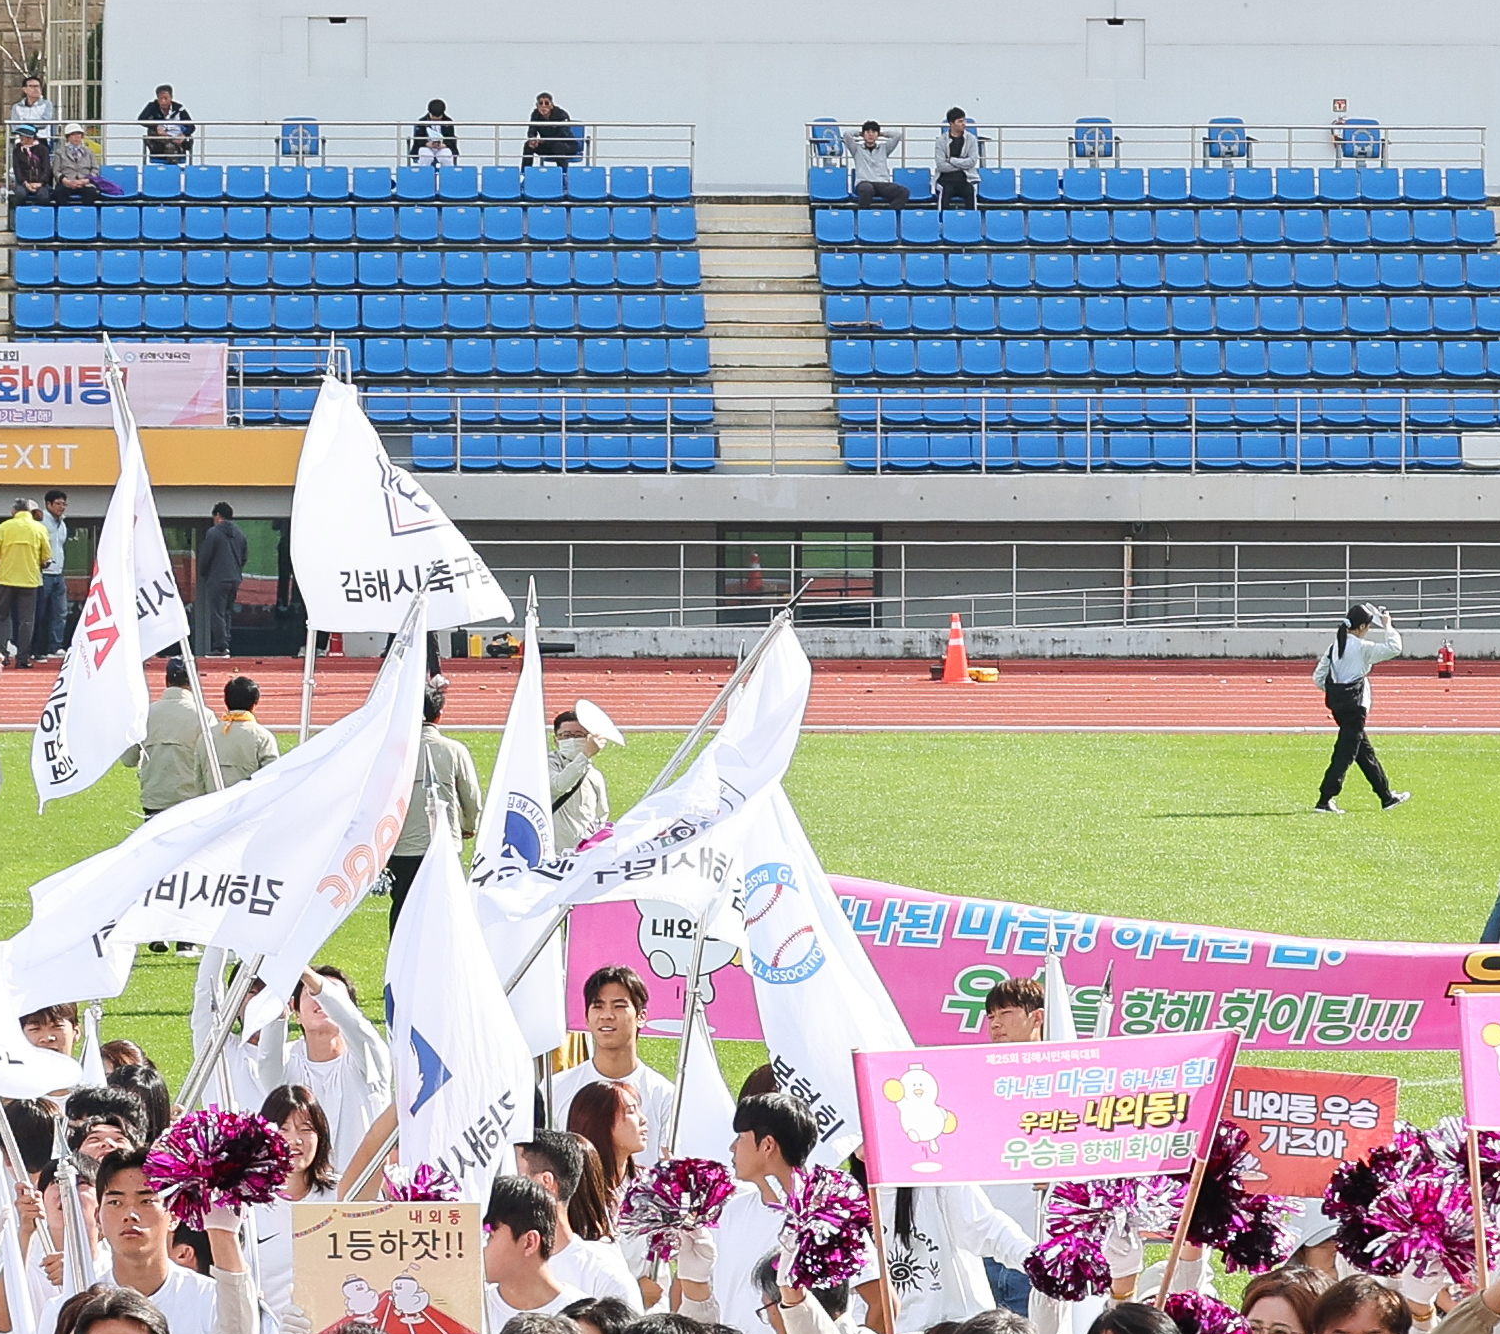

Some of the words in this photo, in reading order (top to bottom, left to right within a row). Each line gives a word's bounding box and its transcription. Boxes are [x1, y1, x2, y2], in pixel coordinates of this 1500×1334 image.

[956, 897, 1098, 957] 마음!
[1121, 991, 1204, 1035] 향해
[1216, 987, 1425, 1043] 화이팅!!!
[994, 1076, 1051, 1098] 하나된
[1057, 1068, 1115, 1095] 마음!
[1122, 1068, 1178, 1090] 하나된
[1182, 1058, 1216, 1087] 힘!
[1019, 1110, 1079, 1134] 우리는
[1083, 1092, 1188, 1131] 내외동!
[1232, 1088, 1318, 1125] 내외동
[1321, 1095, 1379, 1130] 우승
[1002, 1139, 1077, 1169] 우승을
[1082, 1142, 1124, 1164] 향해
[1259, 1124, 1348, 1160] 가즈아
[327, 1229, 464, 1262] 1등하잣!!
